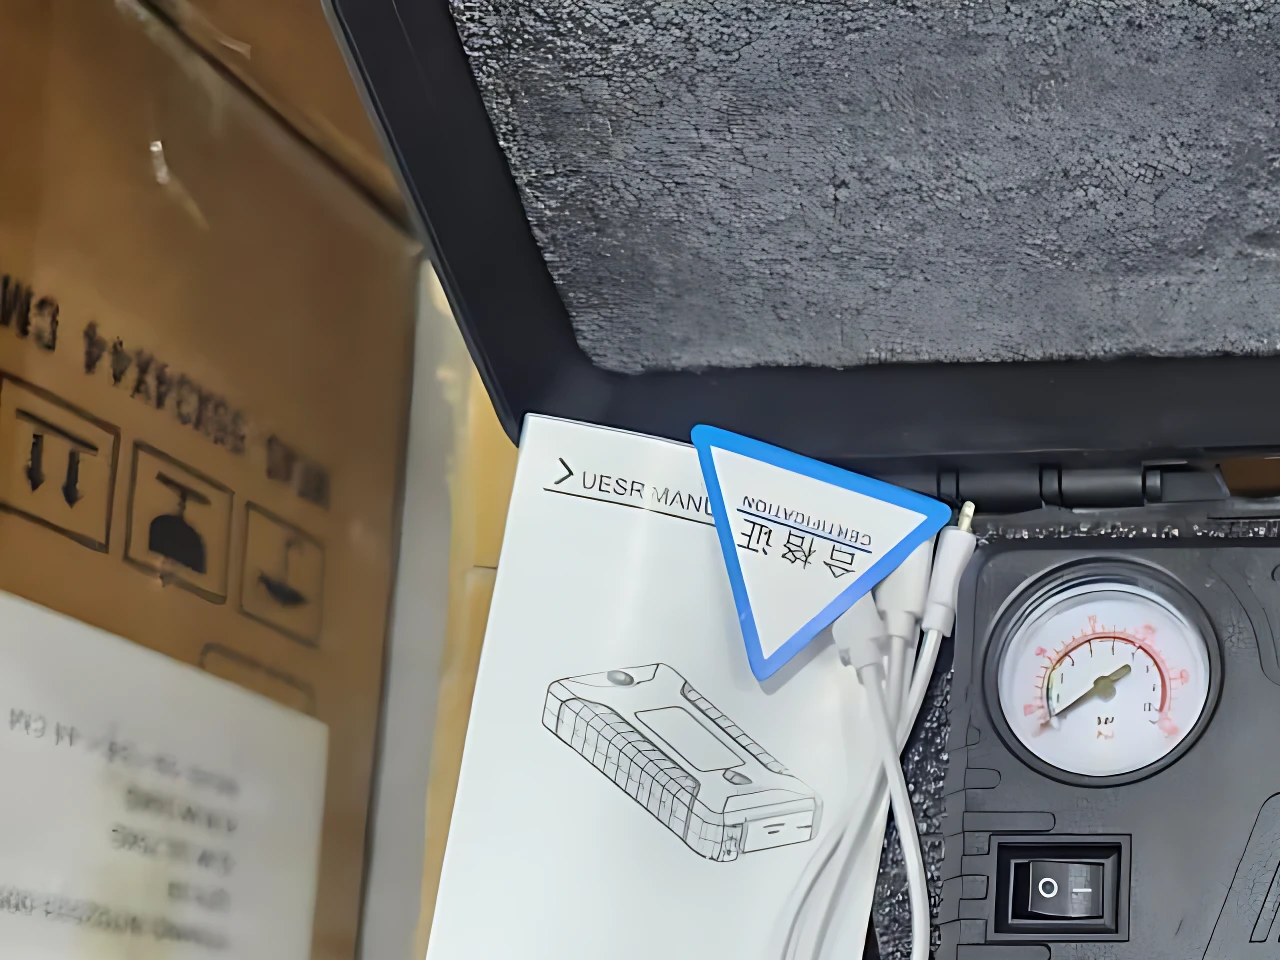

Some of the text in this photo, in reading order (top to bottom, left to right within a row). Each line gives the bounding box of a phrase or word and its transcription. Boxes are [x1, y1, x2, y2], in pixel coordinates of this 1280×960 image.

[582, 471, 646, 500] UESR
[736, 518, 856, 578] 合格证
